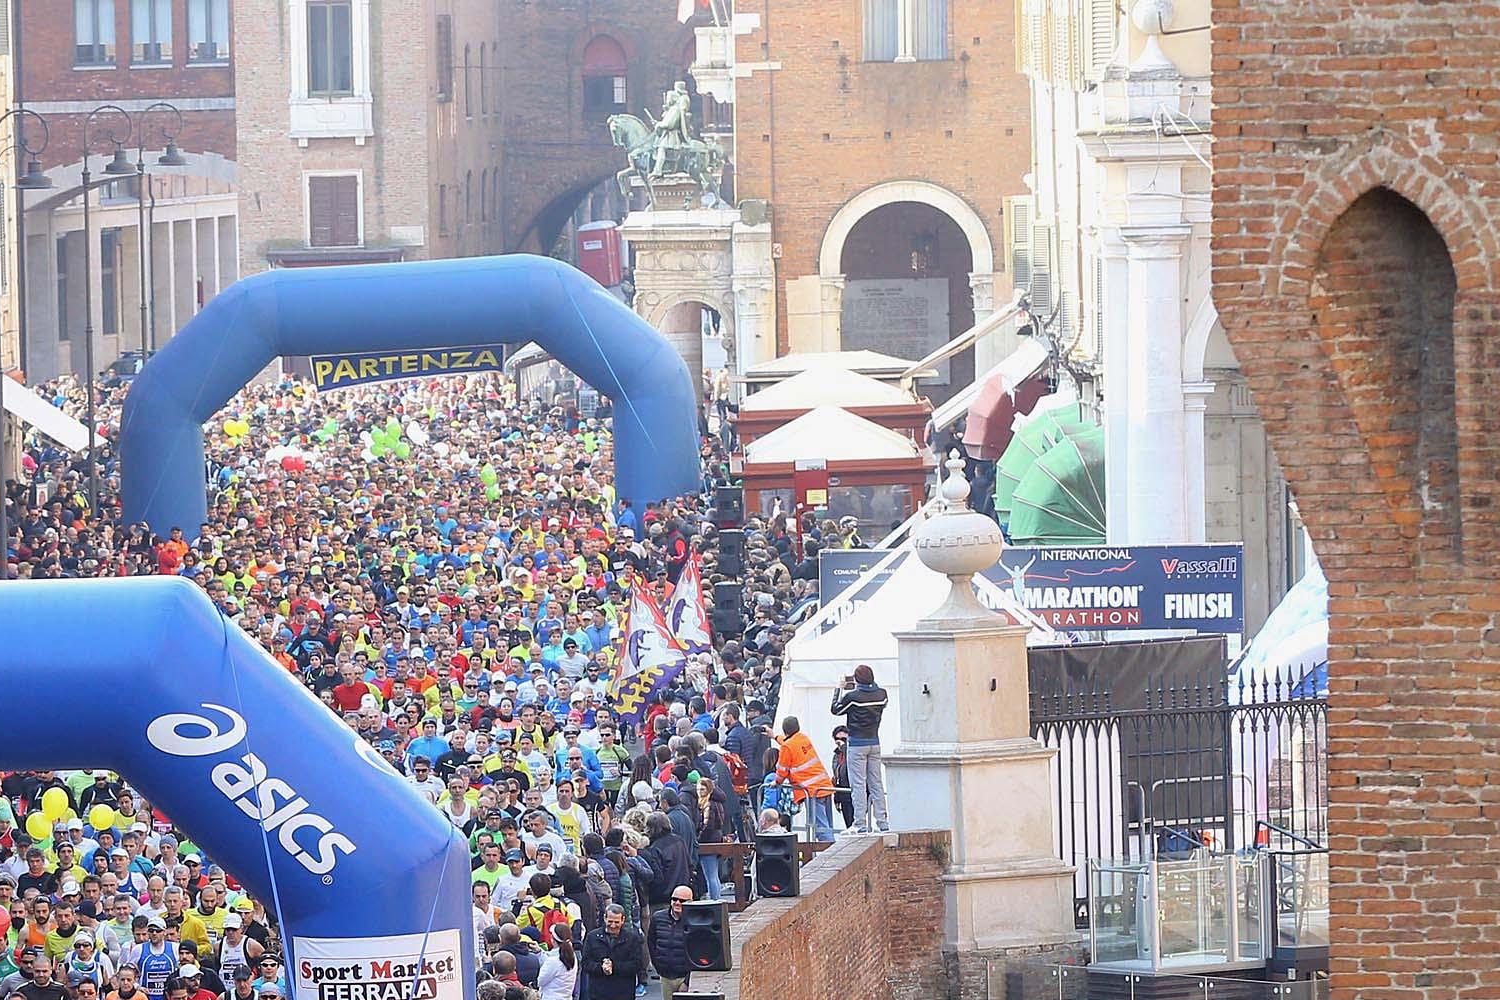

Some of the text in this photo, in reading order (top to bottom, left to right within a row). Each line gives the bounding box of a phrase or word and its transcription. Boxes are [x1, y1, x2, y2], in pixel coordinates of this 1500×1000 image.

[315, 350, 499, 387] PARTENZA
[1041, 549, 1132, 561] INTERNATIONAL
[1160, 556, 1237, 574] Vassalli
[1023, 585, 1138, 609] MARATHON
[1164, 593, 1232, 618] FINISH
[1037, 611, 1138, 625] ARATHON
[211, 752, 357, 875] asics
[301, 955, 453, 983] Sport Market
